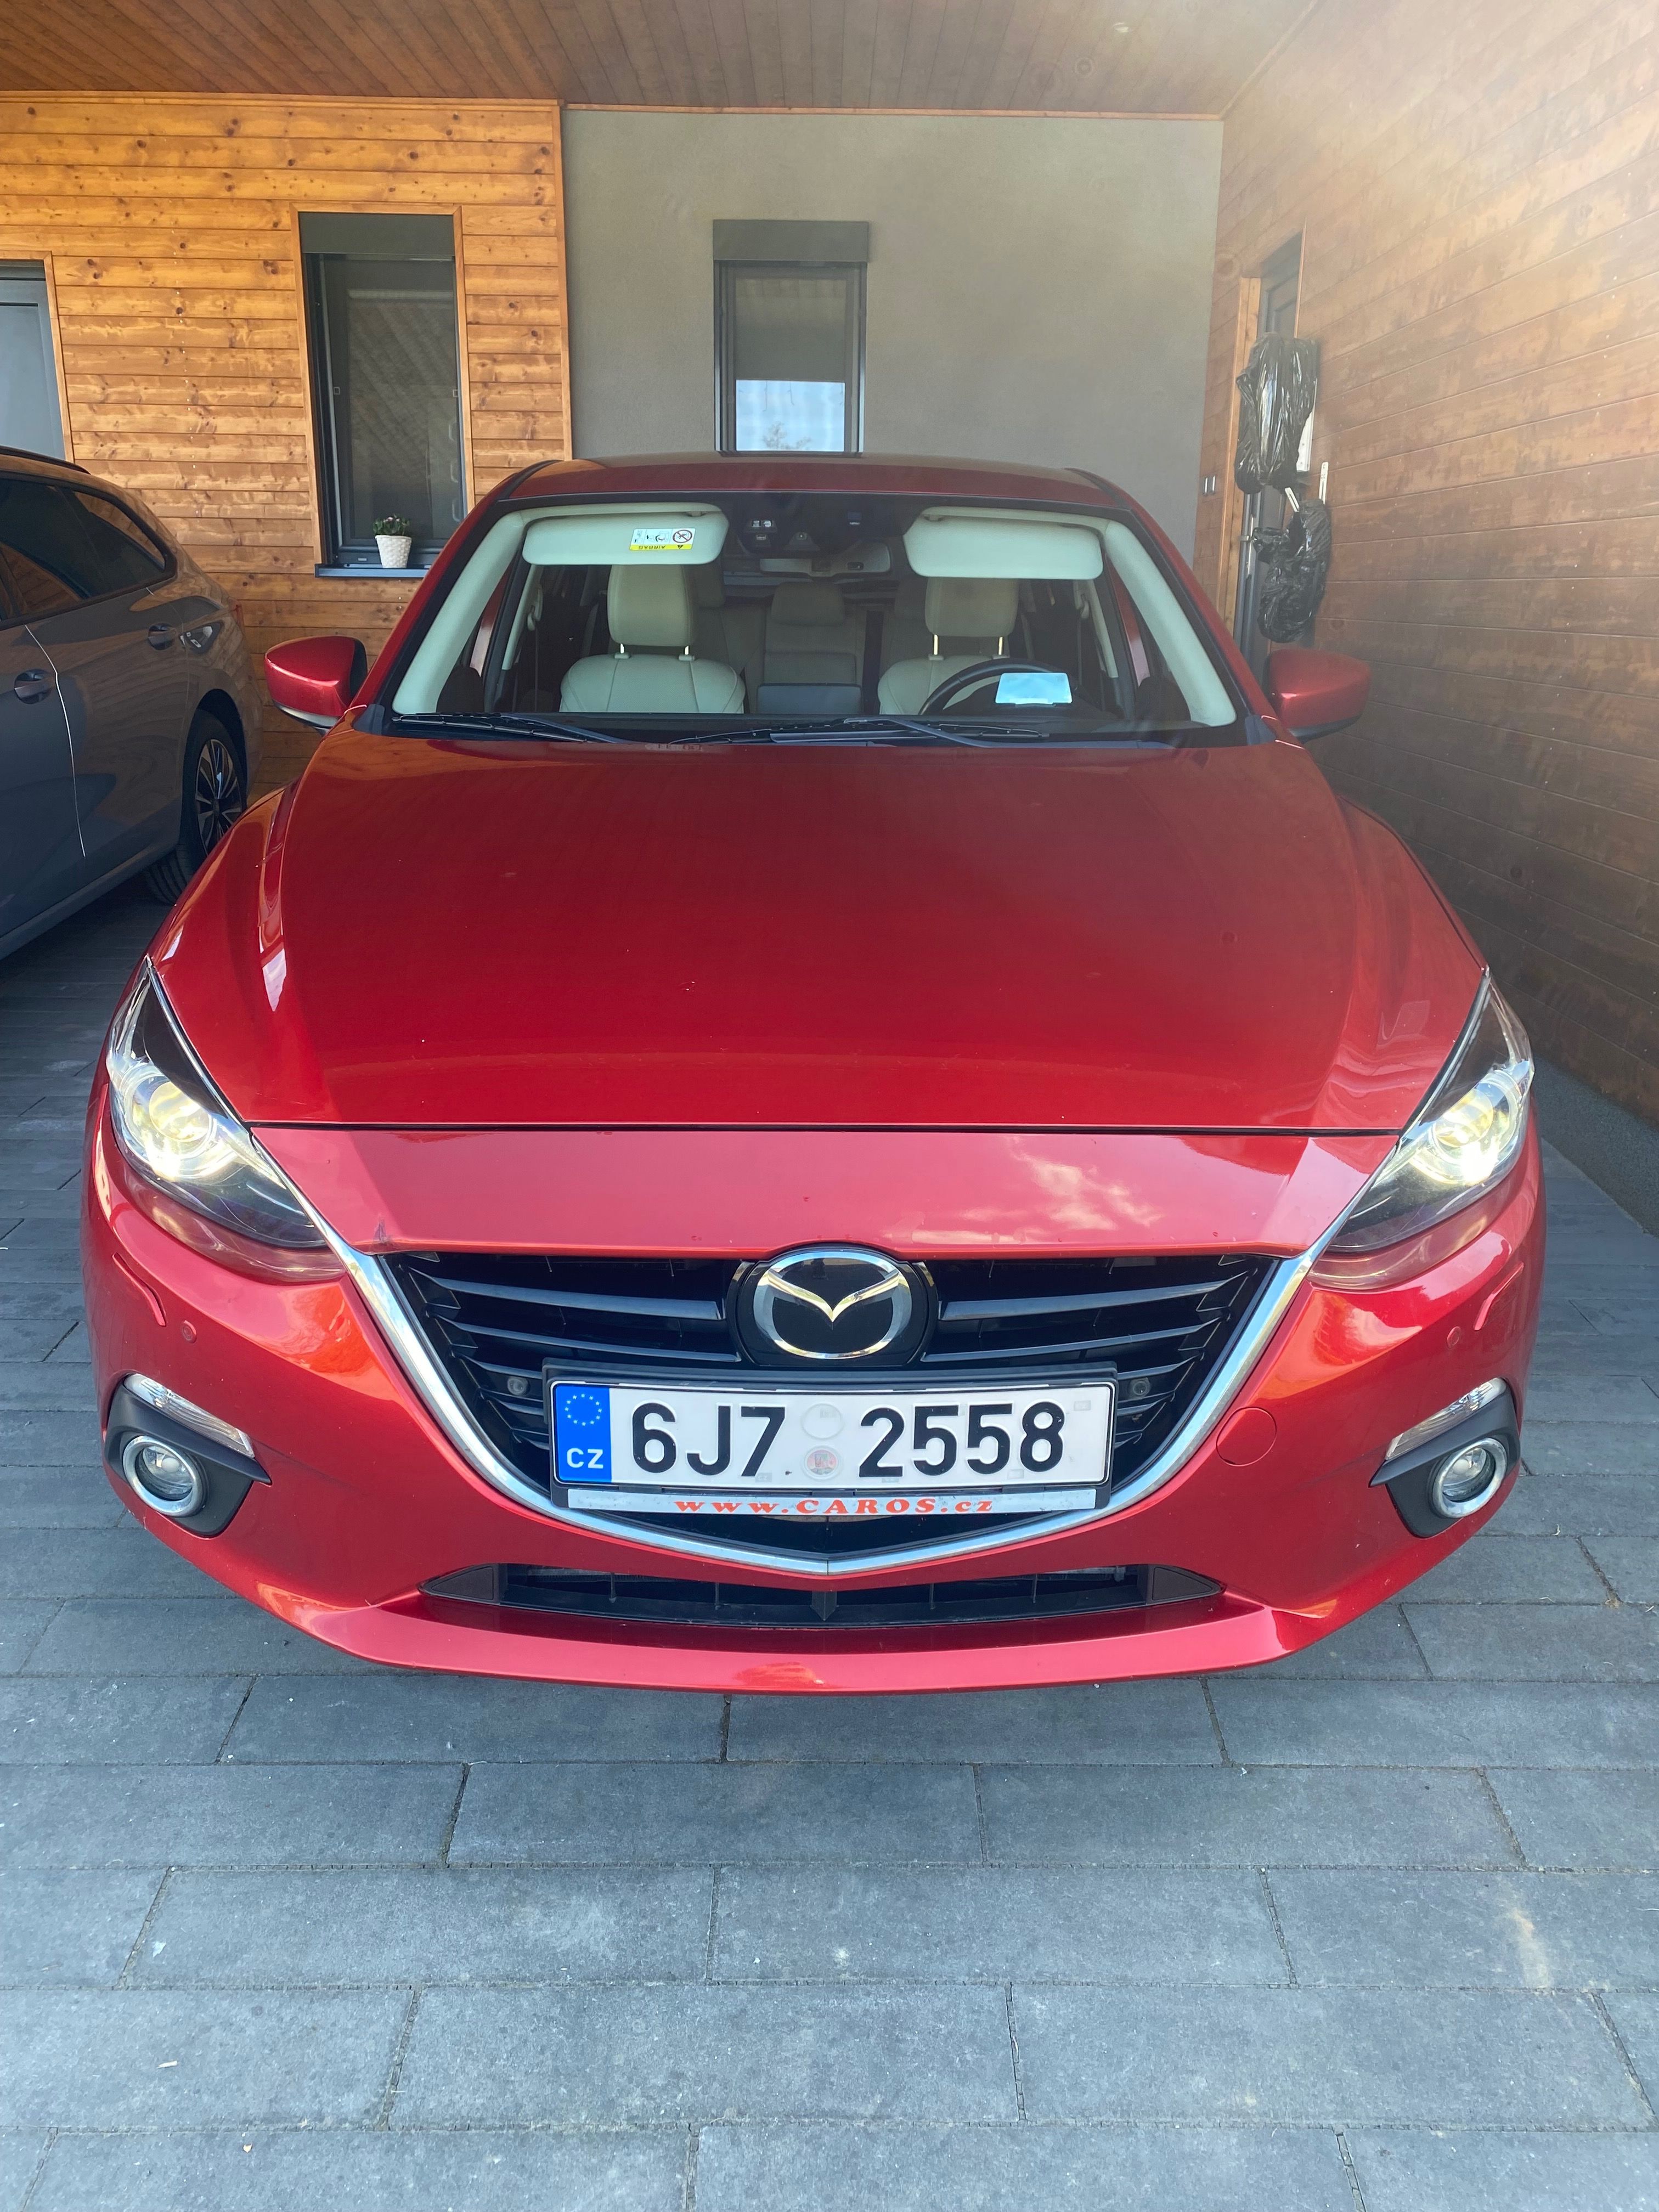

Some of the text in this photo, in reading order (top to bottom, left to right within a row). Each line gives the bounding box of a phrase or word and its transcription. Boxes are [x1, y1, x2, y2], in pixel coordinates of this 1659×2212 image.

[632, 1401, 1065, 1477] 6J7 2558
[567, 1448, 603, 1469] CZ
[674, 1498, 992, 1515] www.CAROS.cz
